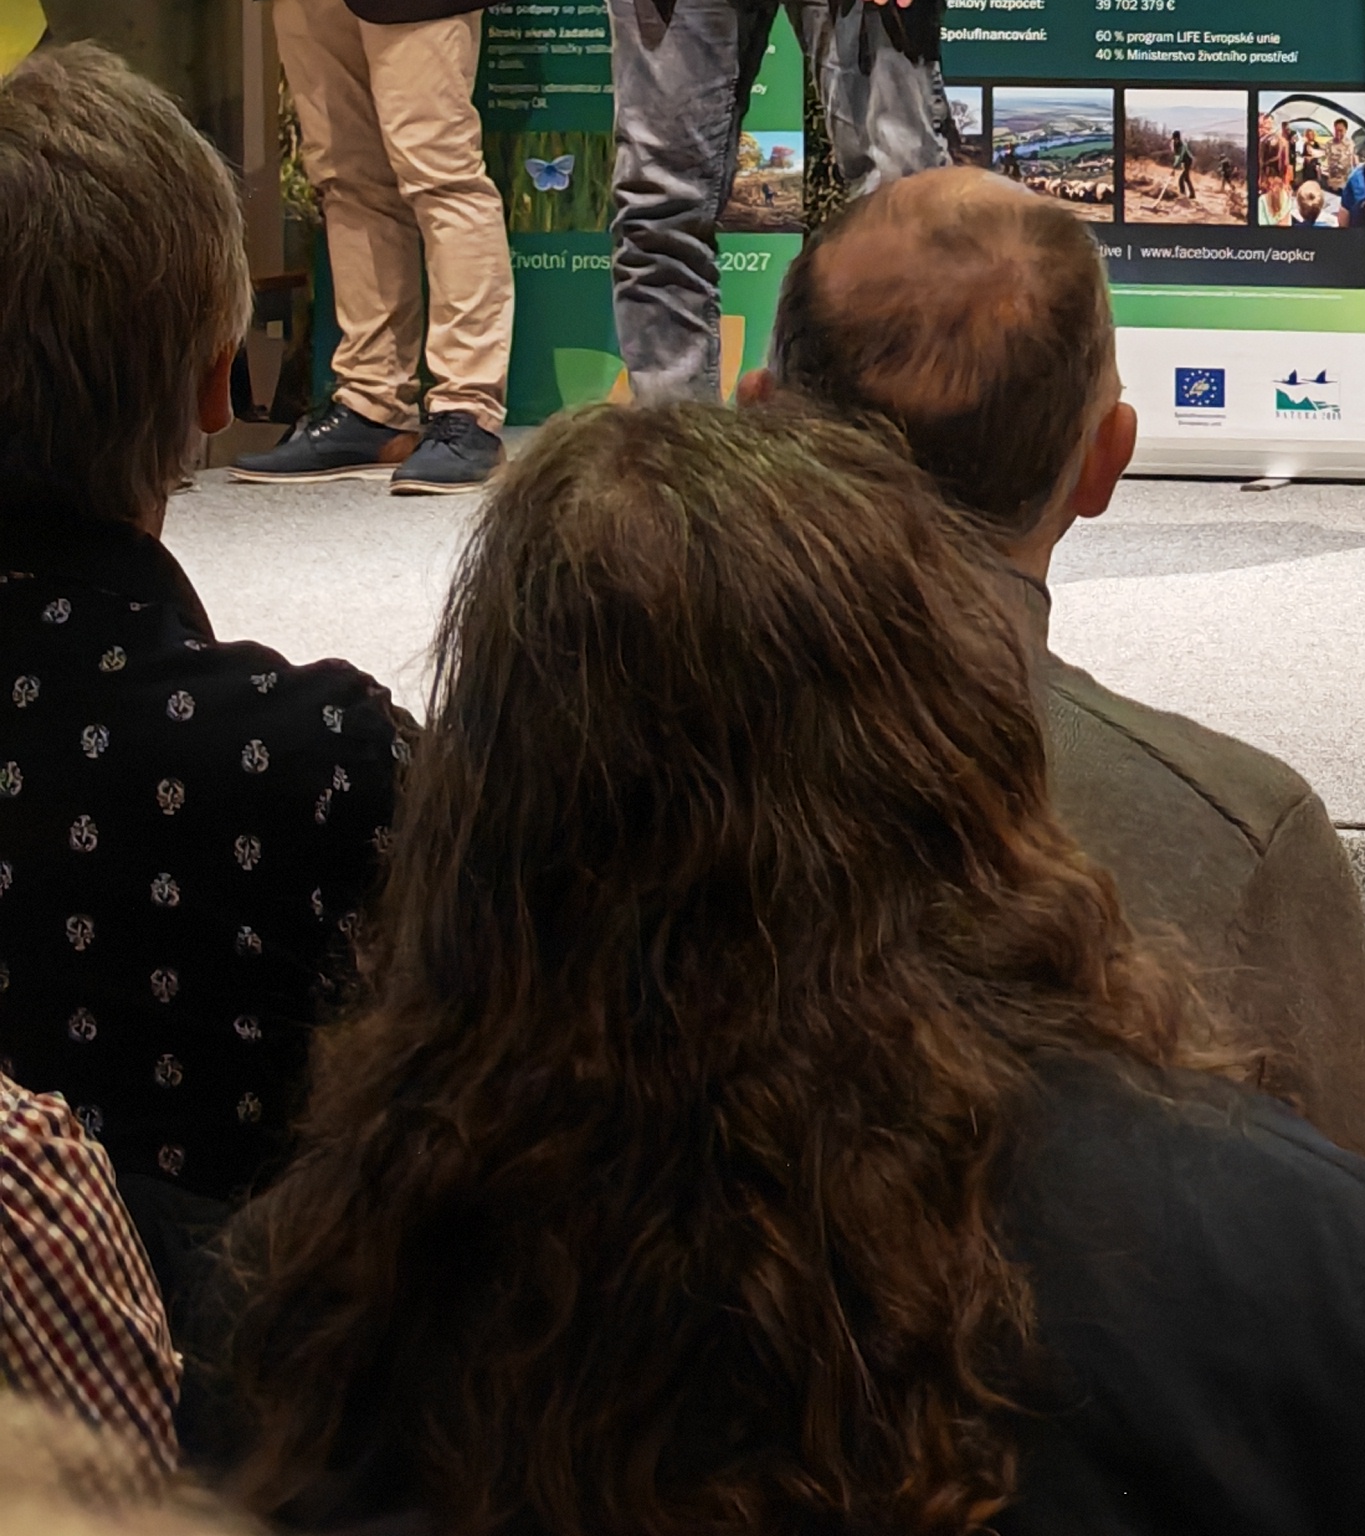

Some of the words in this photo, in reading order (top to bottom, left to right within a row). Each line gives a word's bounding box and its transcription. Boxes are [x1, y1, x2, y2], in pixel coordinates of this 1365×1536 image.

[1096, 0, 1110, 10] 39
[1115, 0, 1138, 10] 702
[1141, 0, 1164, 10] 379
[1166, 0, 1176, 11] €
[940, 27, 1047, 41] Spolufinancování:
[1096, 32, 1111, 42] 60
[1114, 31, 1124, 42] %
[1127, 33, 1174, 45] program
[1177, 32, 1201, 43] LIFE
[1203, 32, 1254, 46] Evropské
[1257, 33, 1280, 44] unie
[1095, 49, 1111, 60] 40
[1114, 49, 1124, 60] %
[1127, 50, 1195, 62] Ministerstvo
[1198, 49, 1247, 62] životního
[1250, 50, 1298, 64] prostředí
[1100, 246, 1122, 256] tive
[1140, 246, 1315, 261] www.facebook.com/aopkcr
[572, 254, 611, 272] pros
[720, 252, 771, 271] 2027
